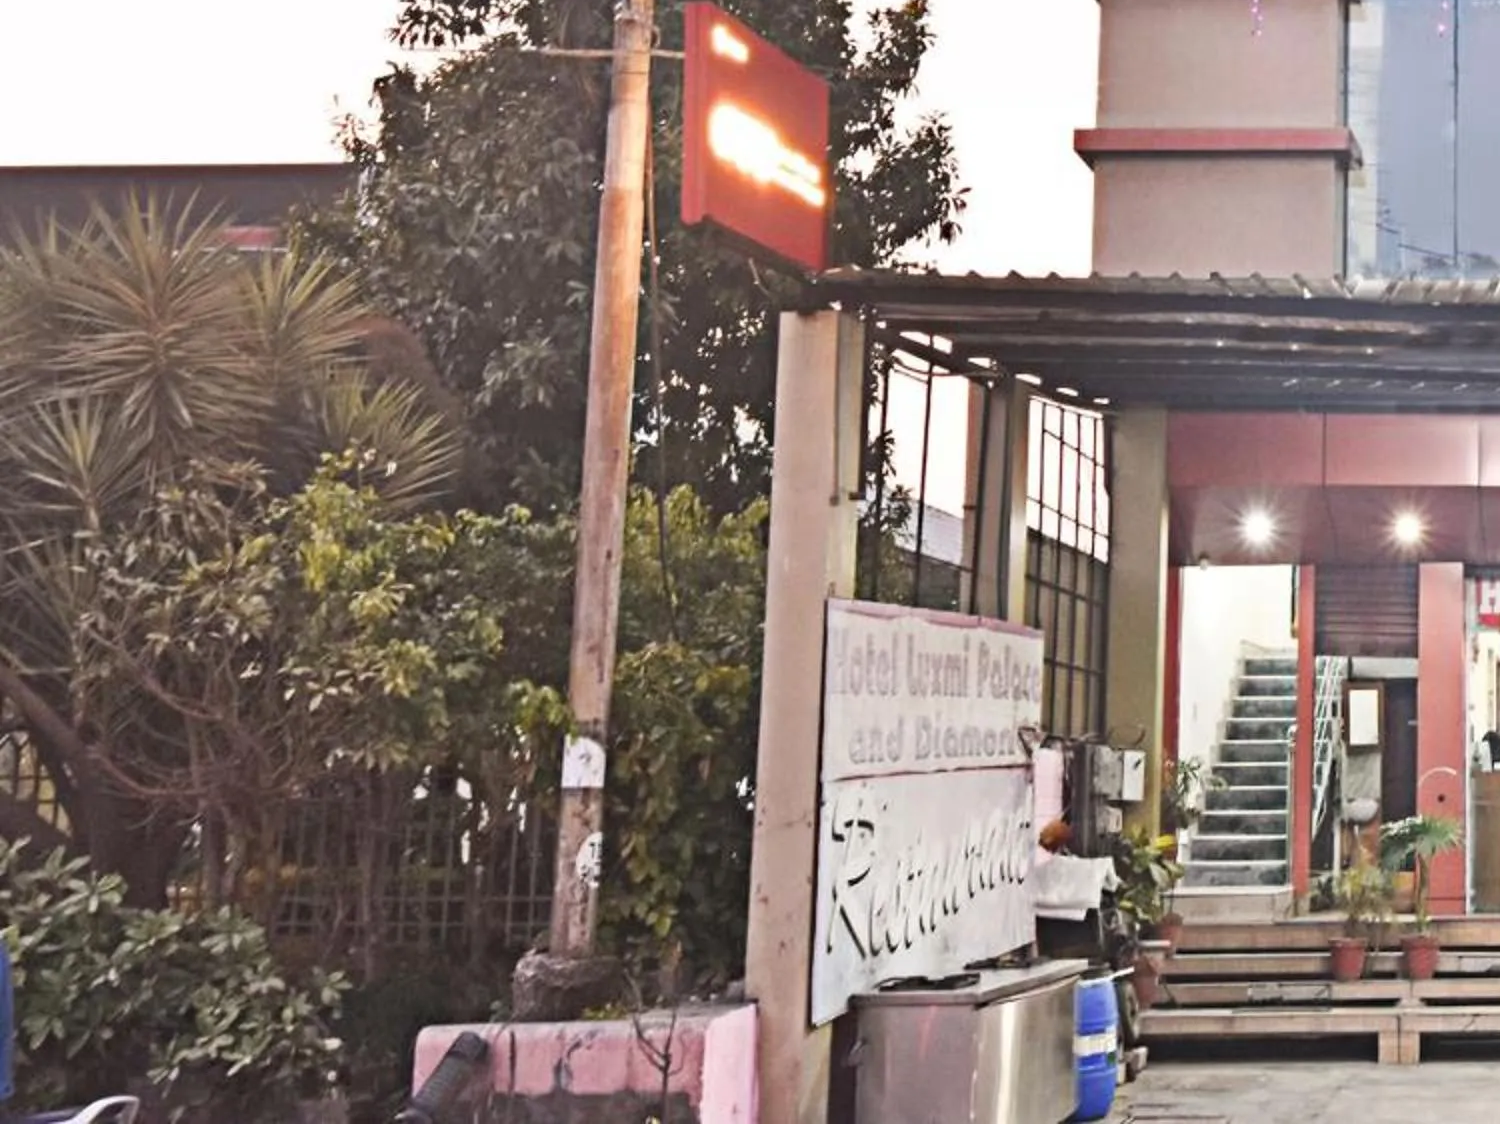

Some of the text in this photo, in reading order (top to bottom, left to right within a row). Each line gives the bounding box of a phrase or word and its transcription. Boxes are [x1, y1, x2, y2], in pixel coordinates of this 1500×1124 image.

[833, 626, 900, 697] Hotel
[977, 638, 1041, 702] Palace
[850, 712, 1028, 764] and Diamon
